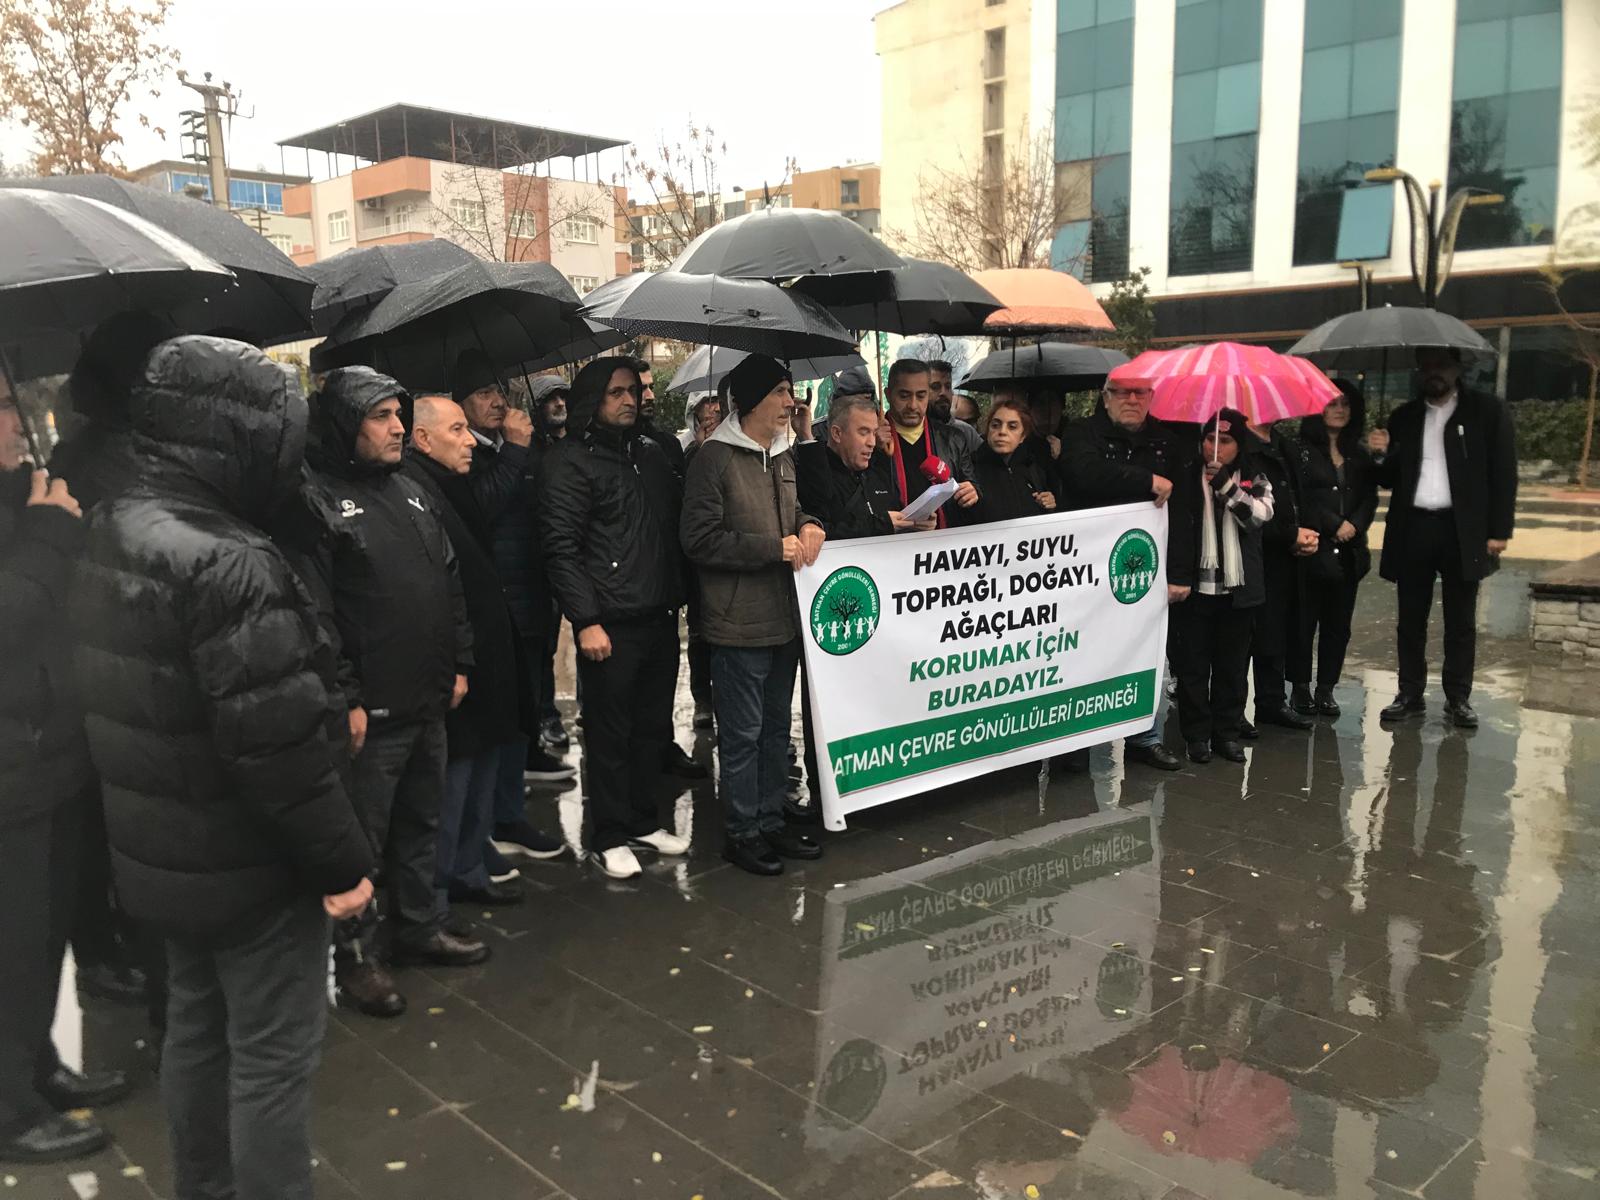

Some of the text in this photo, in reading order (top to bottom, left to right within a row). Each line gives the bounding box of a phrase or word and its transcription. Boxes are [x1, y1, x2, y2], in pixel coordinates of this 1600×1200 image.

[913, 534, 1079, 576] HAVAYI, SUYU,
[814, 594, 825, 622] BATMAN
[892, 563, 1100, 615] TOPRAĞI, DOĞAYI,
[939, 603, 1058, 643] AĞAÇLARI
[909, 626, 1080, 682] KORUMAK İÇİN
[928, 666, 1064, 712] BURADAYIZ.
[899, 729, 956, 767] ÇEVRE
[960, 698, 1072, 744] GÖNÜLLÜLERİ
[1075, 686, 1138, 718] DERNEĞİ
